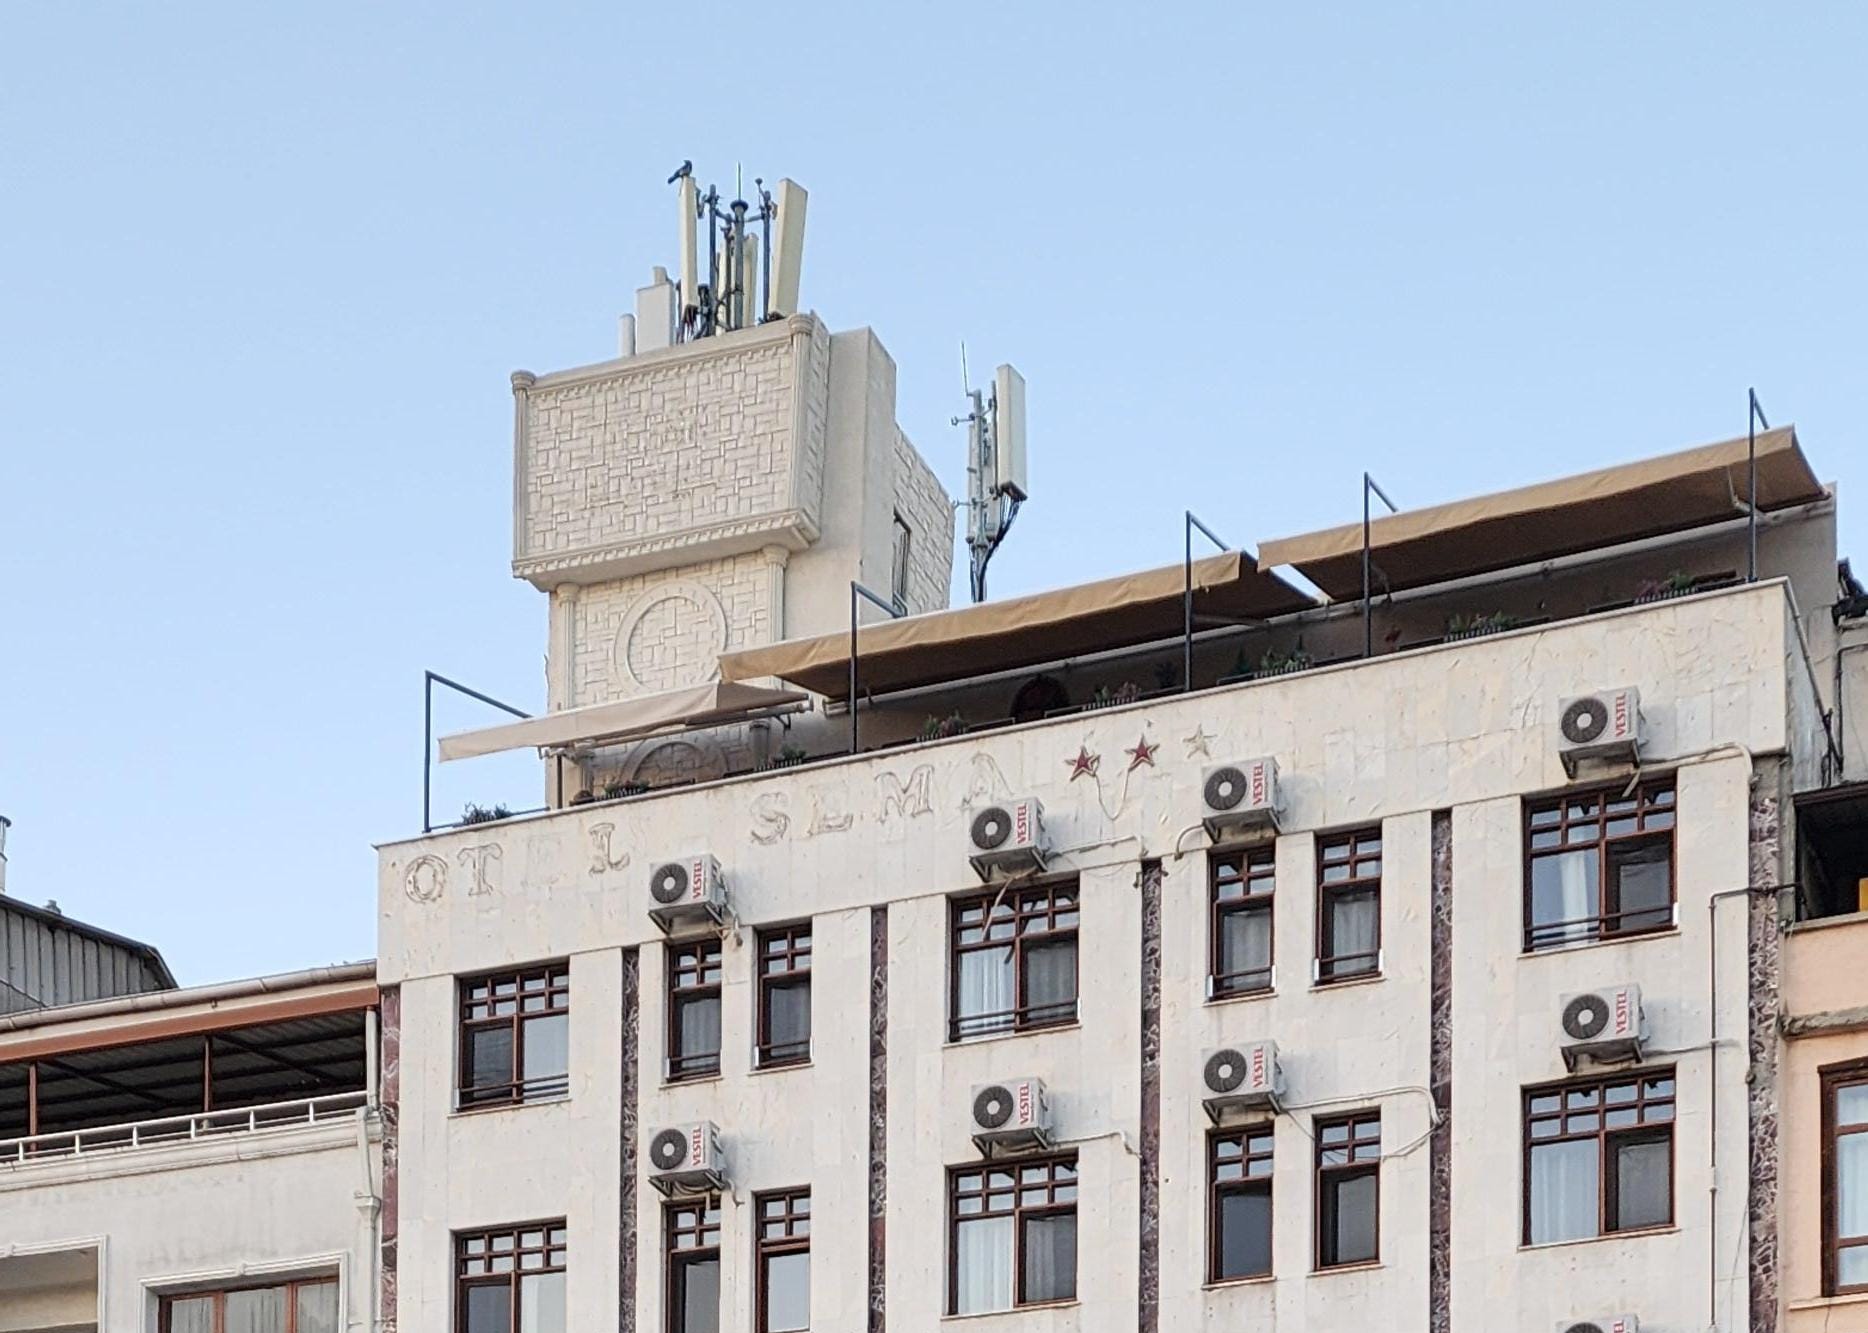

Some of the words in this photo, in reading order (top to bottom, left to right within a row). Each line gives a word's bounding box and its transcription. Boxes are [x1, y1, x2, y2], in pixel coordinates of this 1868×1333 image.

[1616, 693, 1628, 736] VESTEL
[1252, 762, 1264, 804] VESTEL
[1017, 804, 1028, 844] VESTEL
[693, 861, 703, 899] VESTEL
[1616, 992, 1628, 1034] VESTEL
[1252, 1046, 1265, 1088] VESTEL
[1019, 1083, 1030, 1125] VESTEL
[693, 1127, 703, 1165] VESTEL
